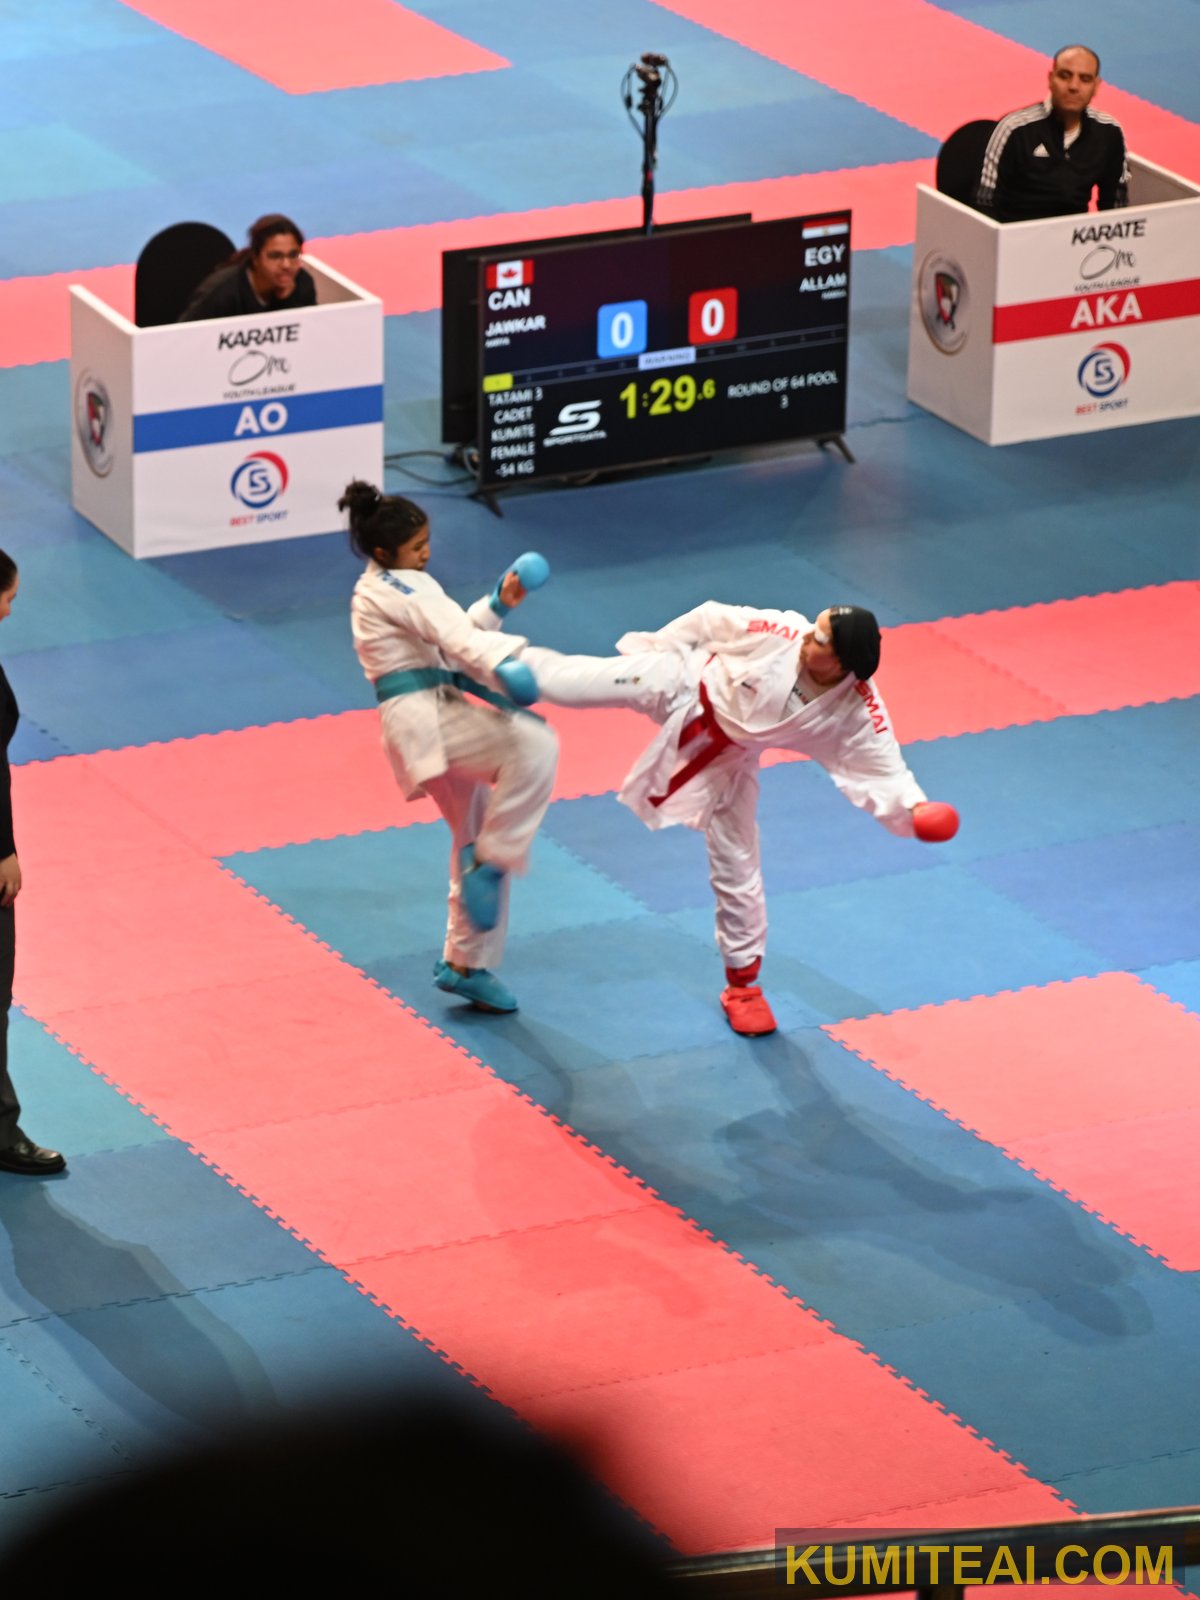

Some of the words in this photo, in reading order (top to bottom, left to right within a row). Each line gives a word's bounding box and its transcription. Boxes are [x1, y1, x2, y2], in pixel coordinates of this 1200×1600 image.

[1071, 218, 1147, 246] KARATE
[804, 242, 847, 267] EGY
[799, 272, 847, 293] ALLAM
[488, 287, 531, 311] CAN
[1070, 291, 1143, 329] AKA
[485, 314, 547, 337] JAWKAR
[701, 298, 725, 336] 0
[217, 323, 301, 351] KARATE
[611, 311, 634, 349] 0
[727, 380, 771, 399] ROUND
[772, 376, 789, 392] OF
[807, 370, 839, 386] POOL
[488, 389, 533, 407] TATAMI
[535, 387, 543, 401] 3
[619, 374, 717, 420] 1:29.6
[780, 395, 789, 409] 3
[1099, 397, 1128, 412] SPORT
[234, 402, 289, 436] AO
[493, 405, 534, 425] CADET
[490, 423, 535, 442] KUMITE
[490, 441, 536, 460] FEMALE
[517, 459, 535, 474] KG
[256, 510, 288, 524] SPORT
[746, 618, 799, 642] SMAI
[854, 679, 888, 735] SMAI
